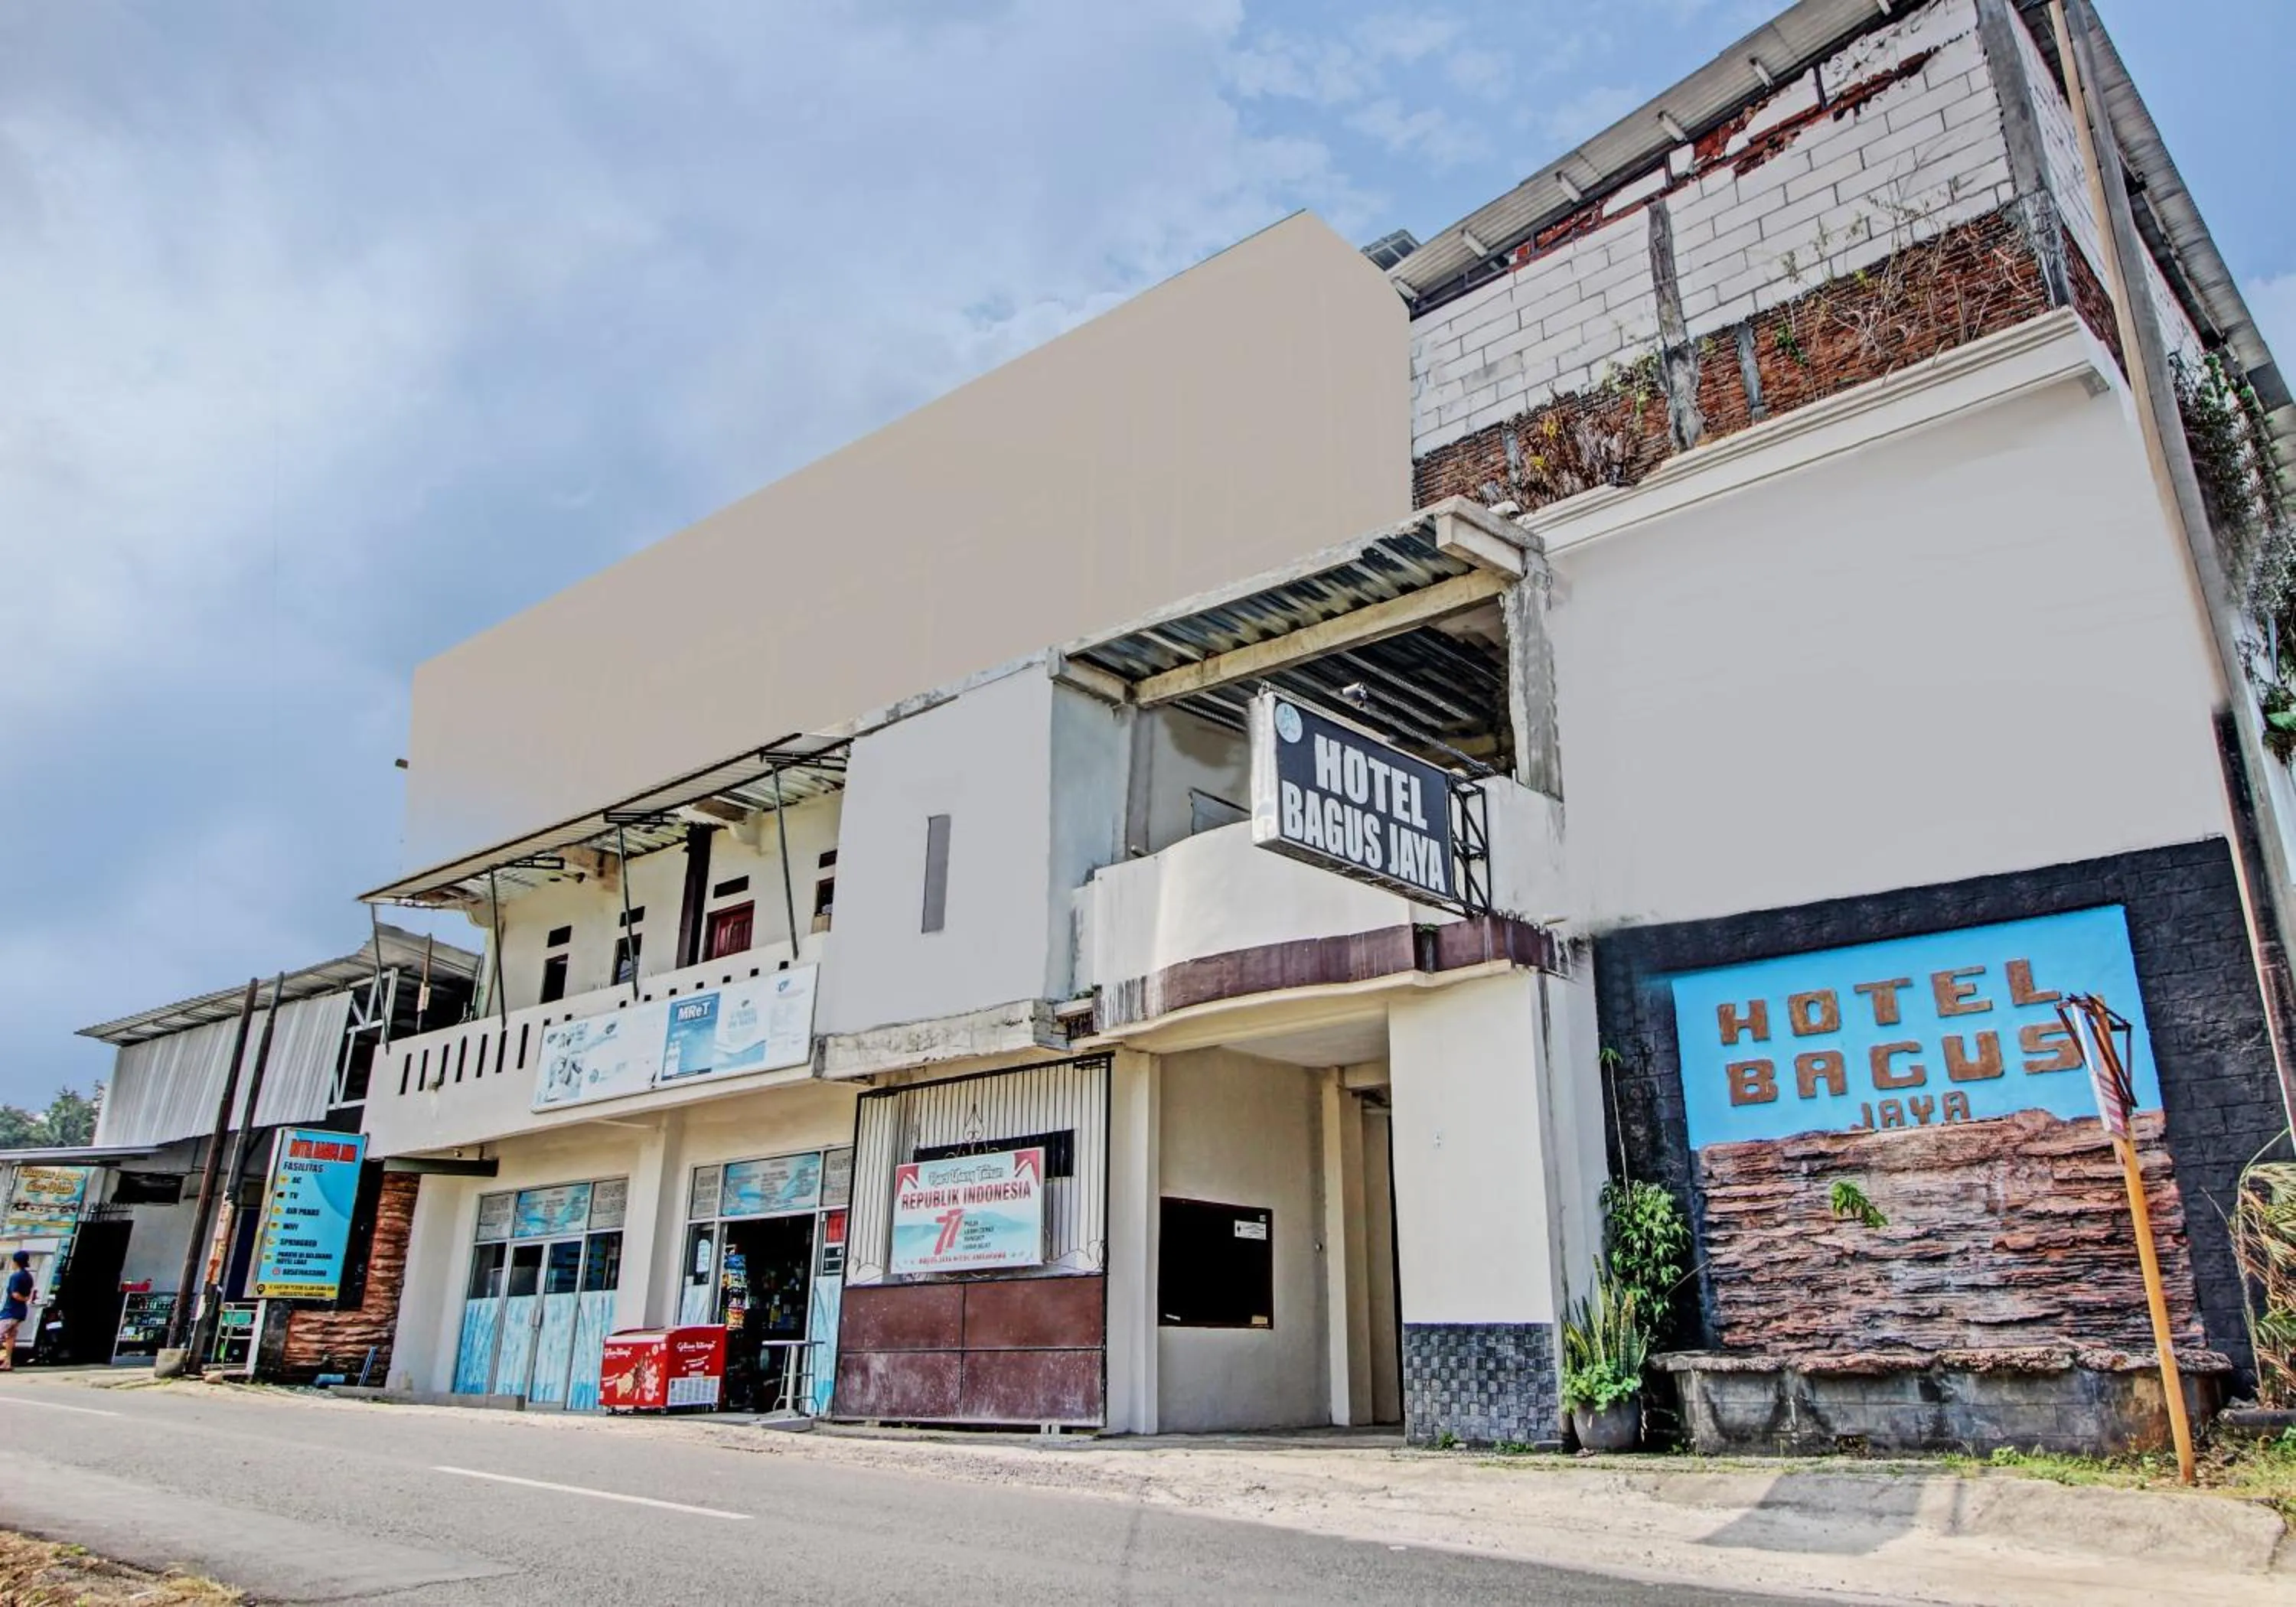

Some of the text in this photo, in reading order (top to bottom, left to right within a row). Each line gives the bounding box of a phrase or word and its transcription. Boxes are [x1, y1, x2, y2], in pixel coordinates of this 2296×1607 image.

[1314, 733, 1427, 830] HOTEL
[1282, 781, 1446, 894] BAGUS JAYA
[1717, 957, 2062, 1045] HOTEL
[1726, 1022, 2085, 1107] BAGUS
[1849, 1090, 1971, 1131] JAYA
[283, 1162, 324, 1173] FASILITAS
[902, 1181, 1031, 1210] REPUBLIK INDONESIA
[934, 1208, 966, 1256] 77
